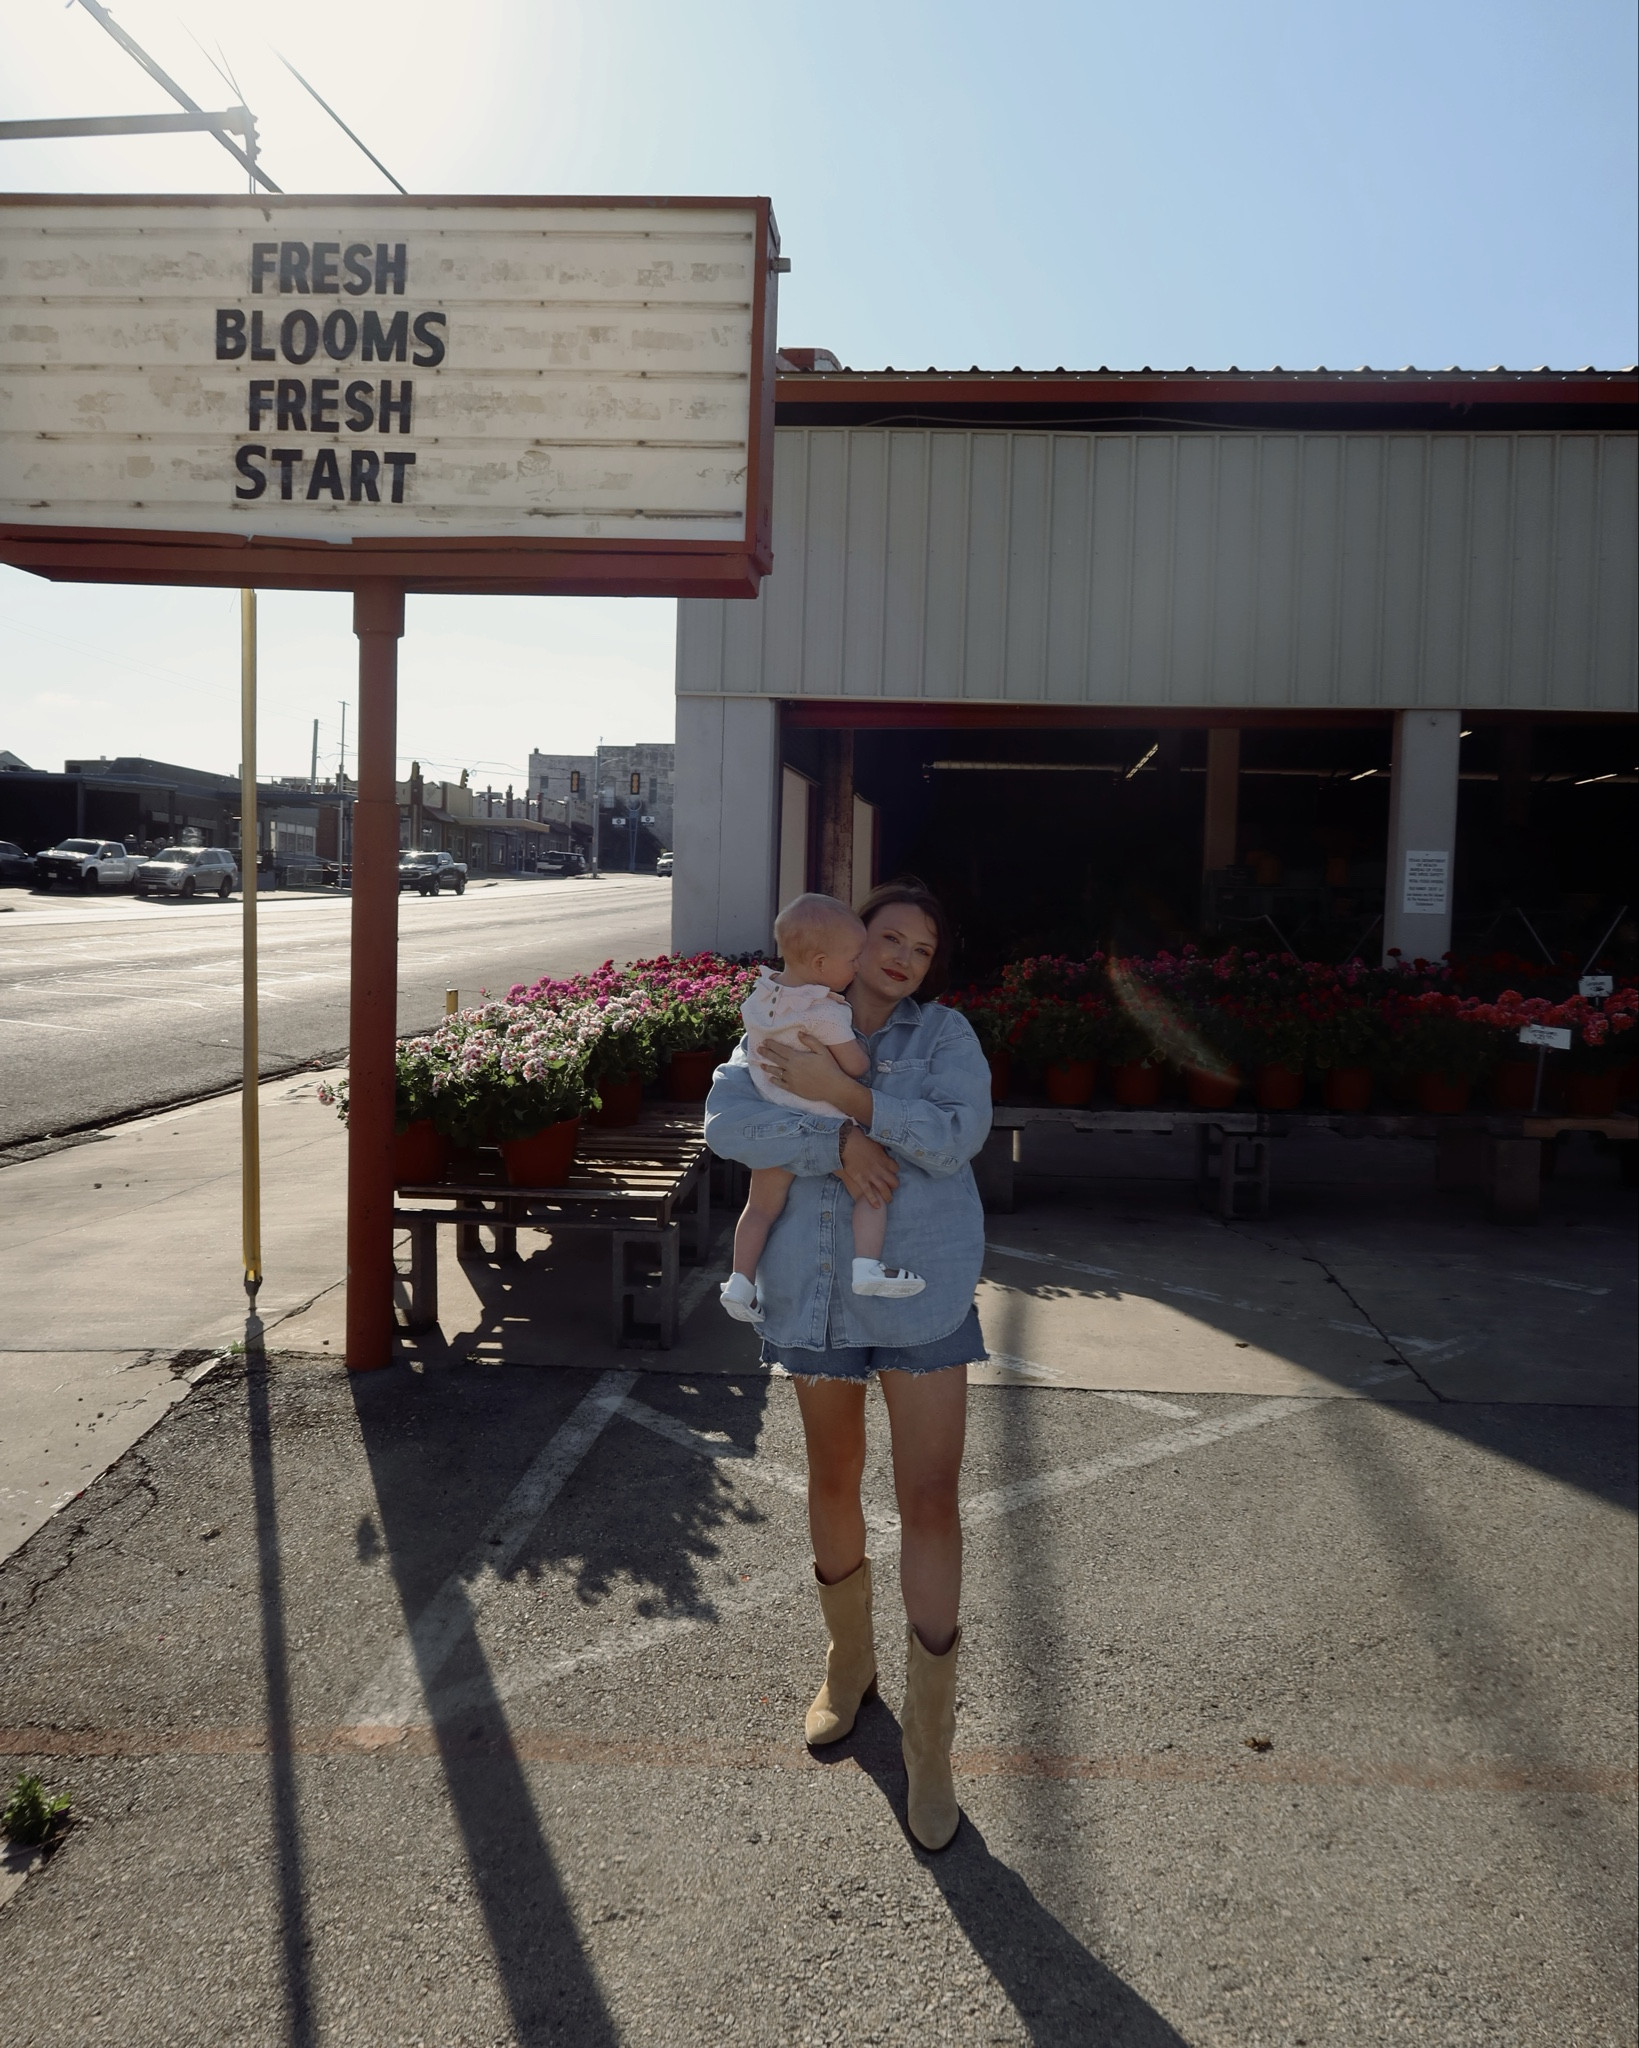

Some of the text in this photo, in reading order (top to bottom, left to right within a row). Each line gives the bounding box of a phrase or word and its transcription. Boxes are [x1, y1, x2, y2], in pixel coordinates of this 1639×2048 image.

[251, 241, 407, 296] FRESH
[215, 308, 447, 368] BLOOMS
[248, 378, 413, 434] FRESH
[235, 444, 416, 504] START
